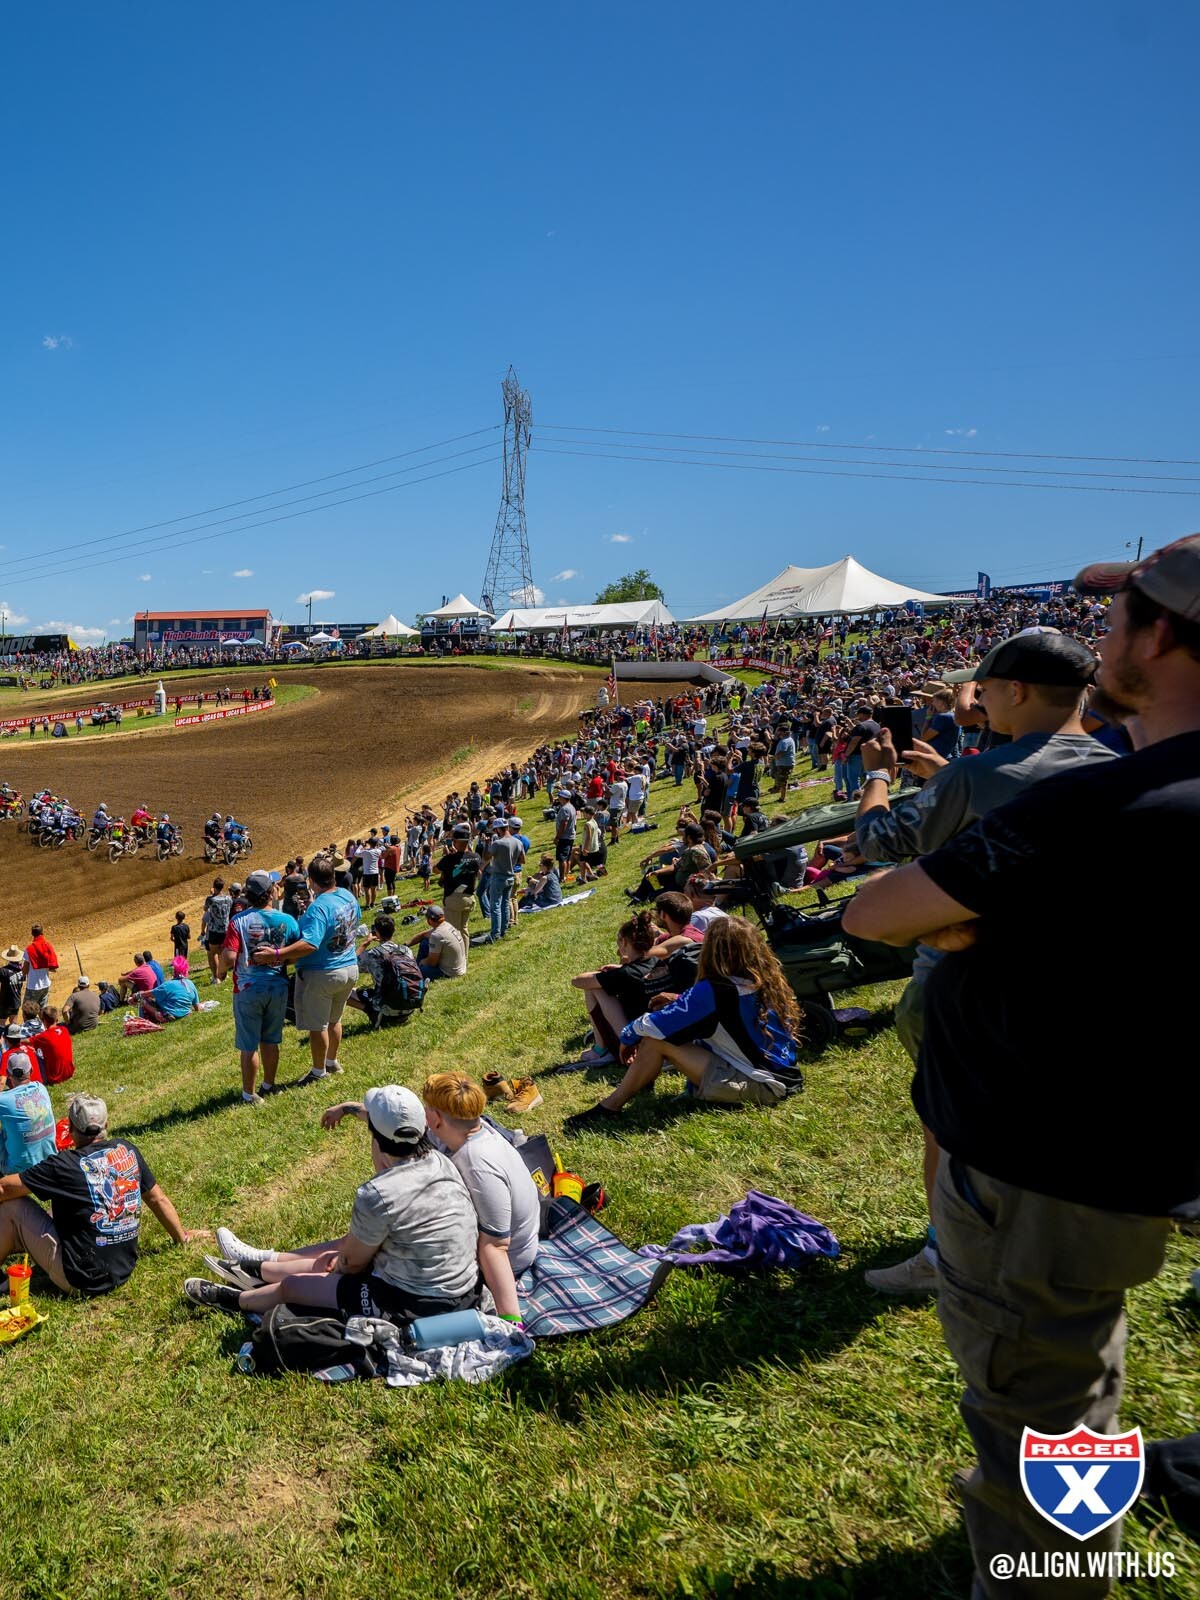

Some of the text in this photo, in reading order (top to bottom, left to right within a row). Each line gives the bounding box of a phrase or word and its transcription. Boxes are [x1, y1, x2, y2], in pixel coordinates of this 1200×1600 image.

[163, 630, 251, 641] High Point Raceway
[176, 717, 191, 726] LUCAS
[202, 713, 217, 722] LUCAS
[360, 1283, 371, 1316] Reeb
